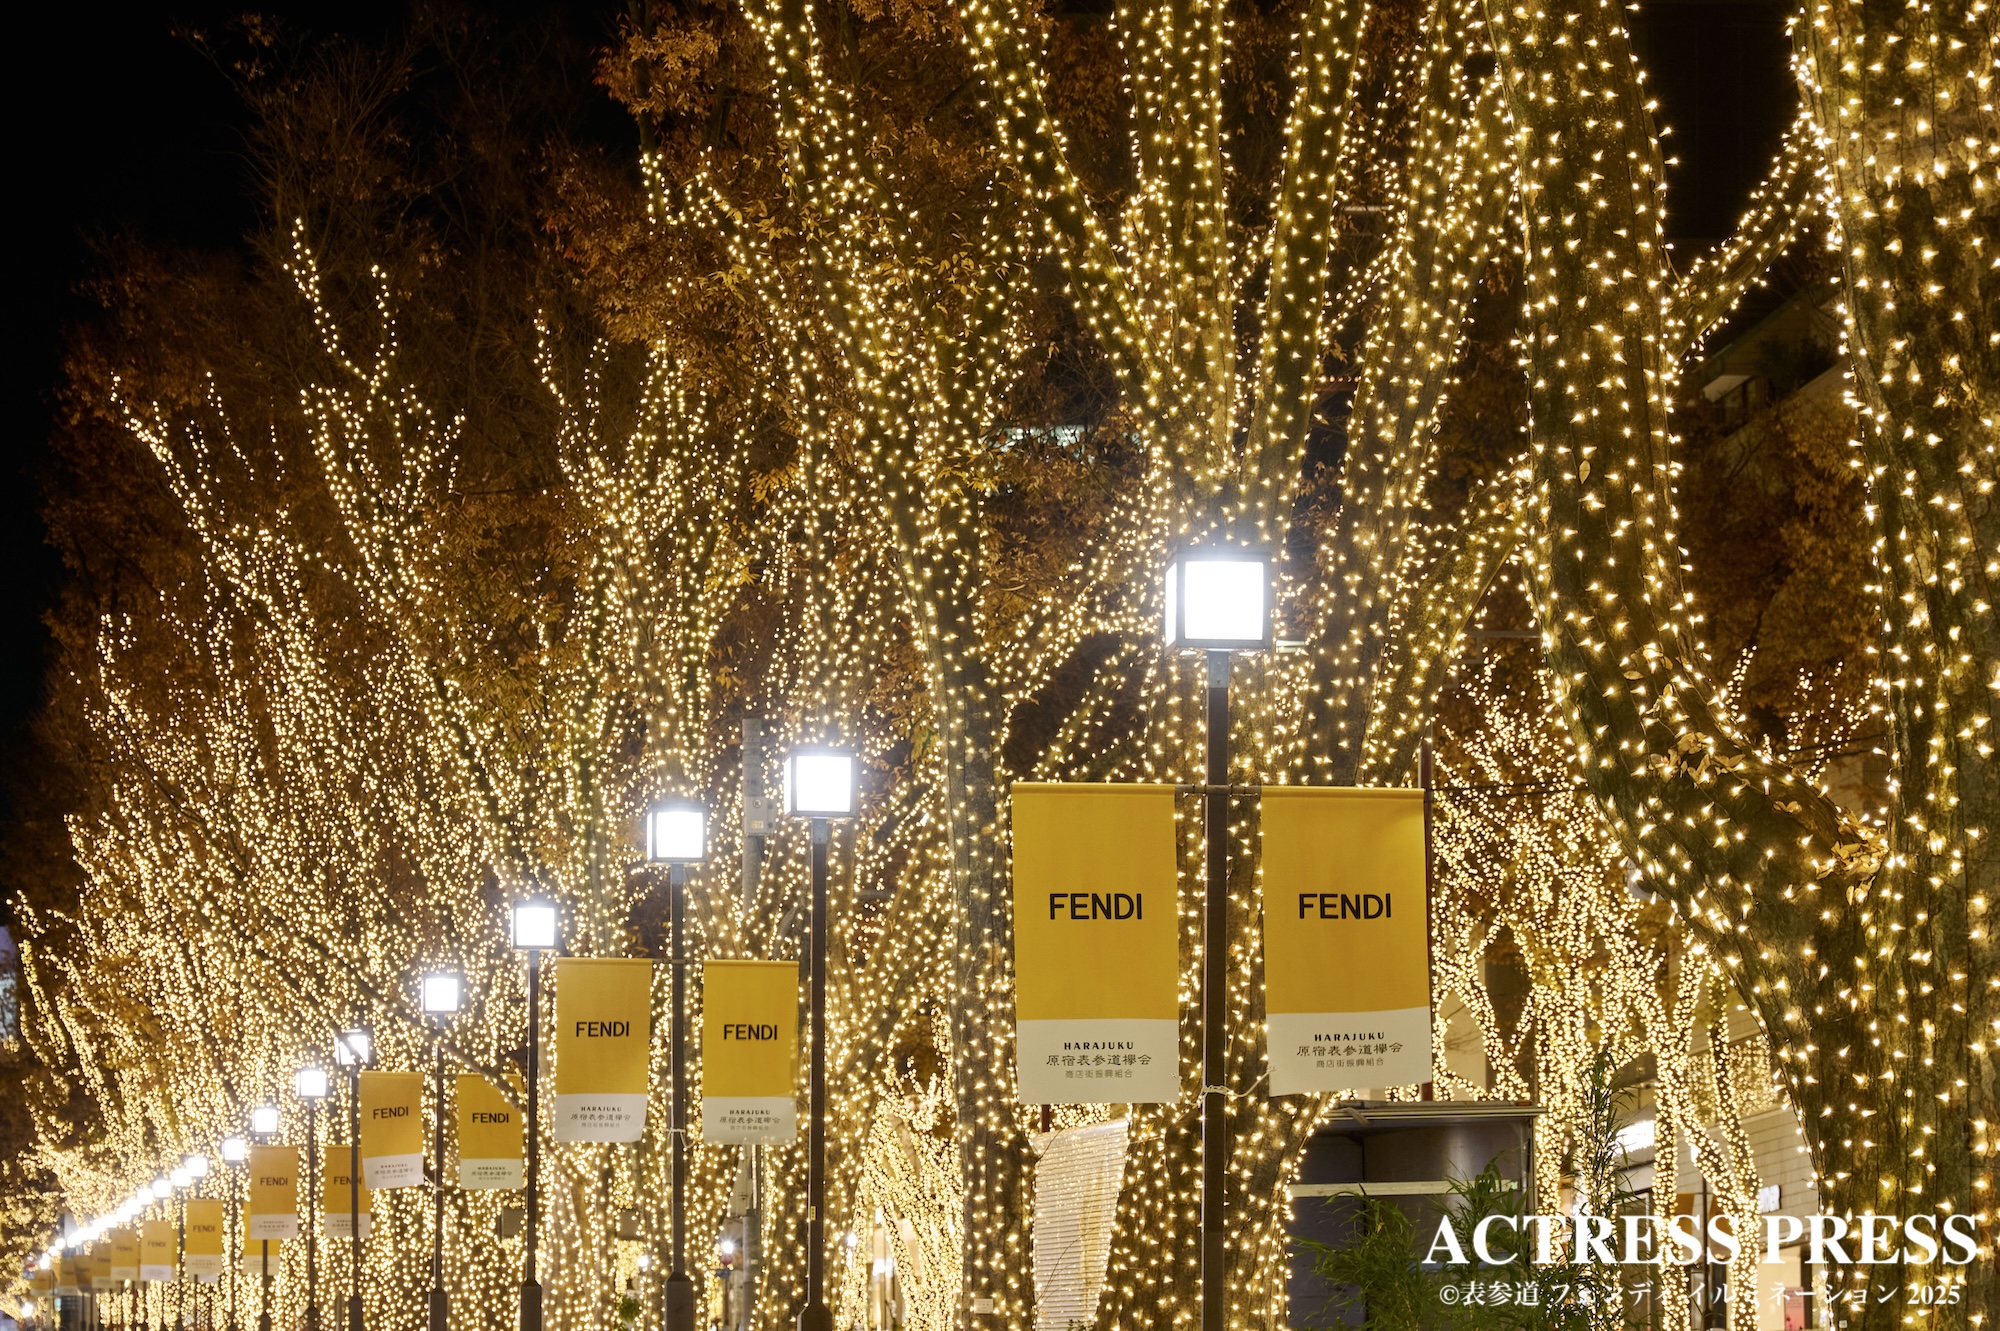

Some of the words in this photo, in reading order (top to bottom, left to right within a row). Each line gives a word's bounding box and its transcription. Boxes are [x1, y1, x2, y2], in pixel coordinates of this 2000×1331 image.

[1049, 893, 1142, 920] FENDI
[1298, 893, 1392, 920] FENDI
[576, 1021, 630, 1038] FENDI
[723, 1024, 778, 1041] FENDI
[1314, 1032, 1385, 1042] HARAJUKU
[1064, 1041, 1134, 1050] HARAJUKU
[372, 1106, 409, 1120] FENDI
[472, 1112, 509, 1124] FENDI
[259, 1177, 289, 1186] FENDI
[192, 1224, 216, 1233] FENDI
